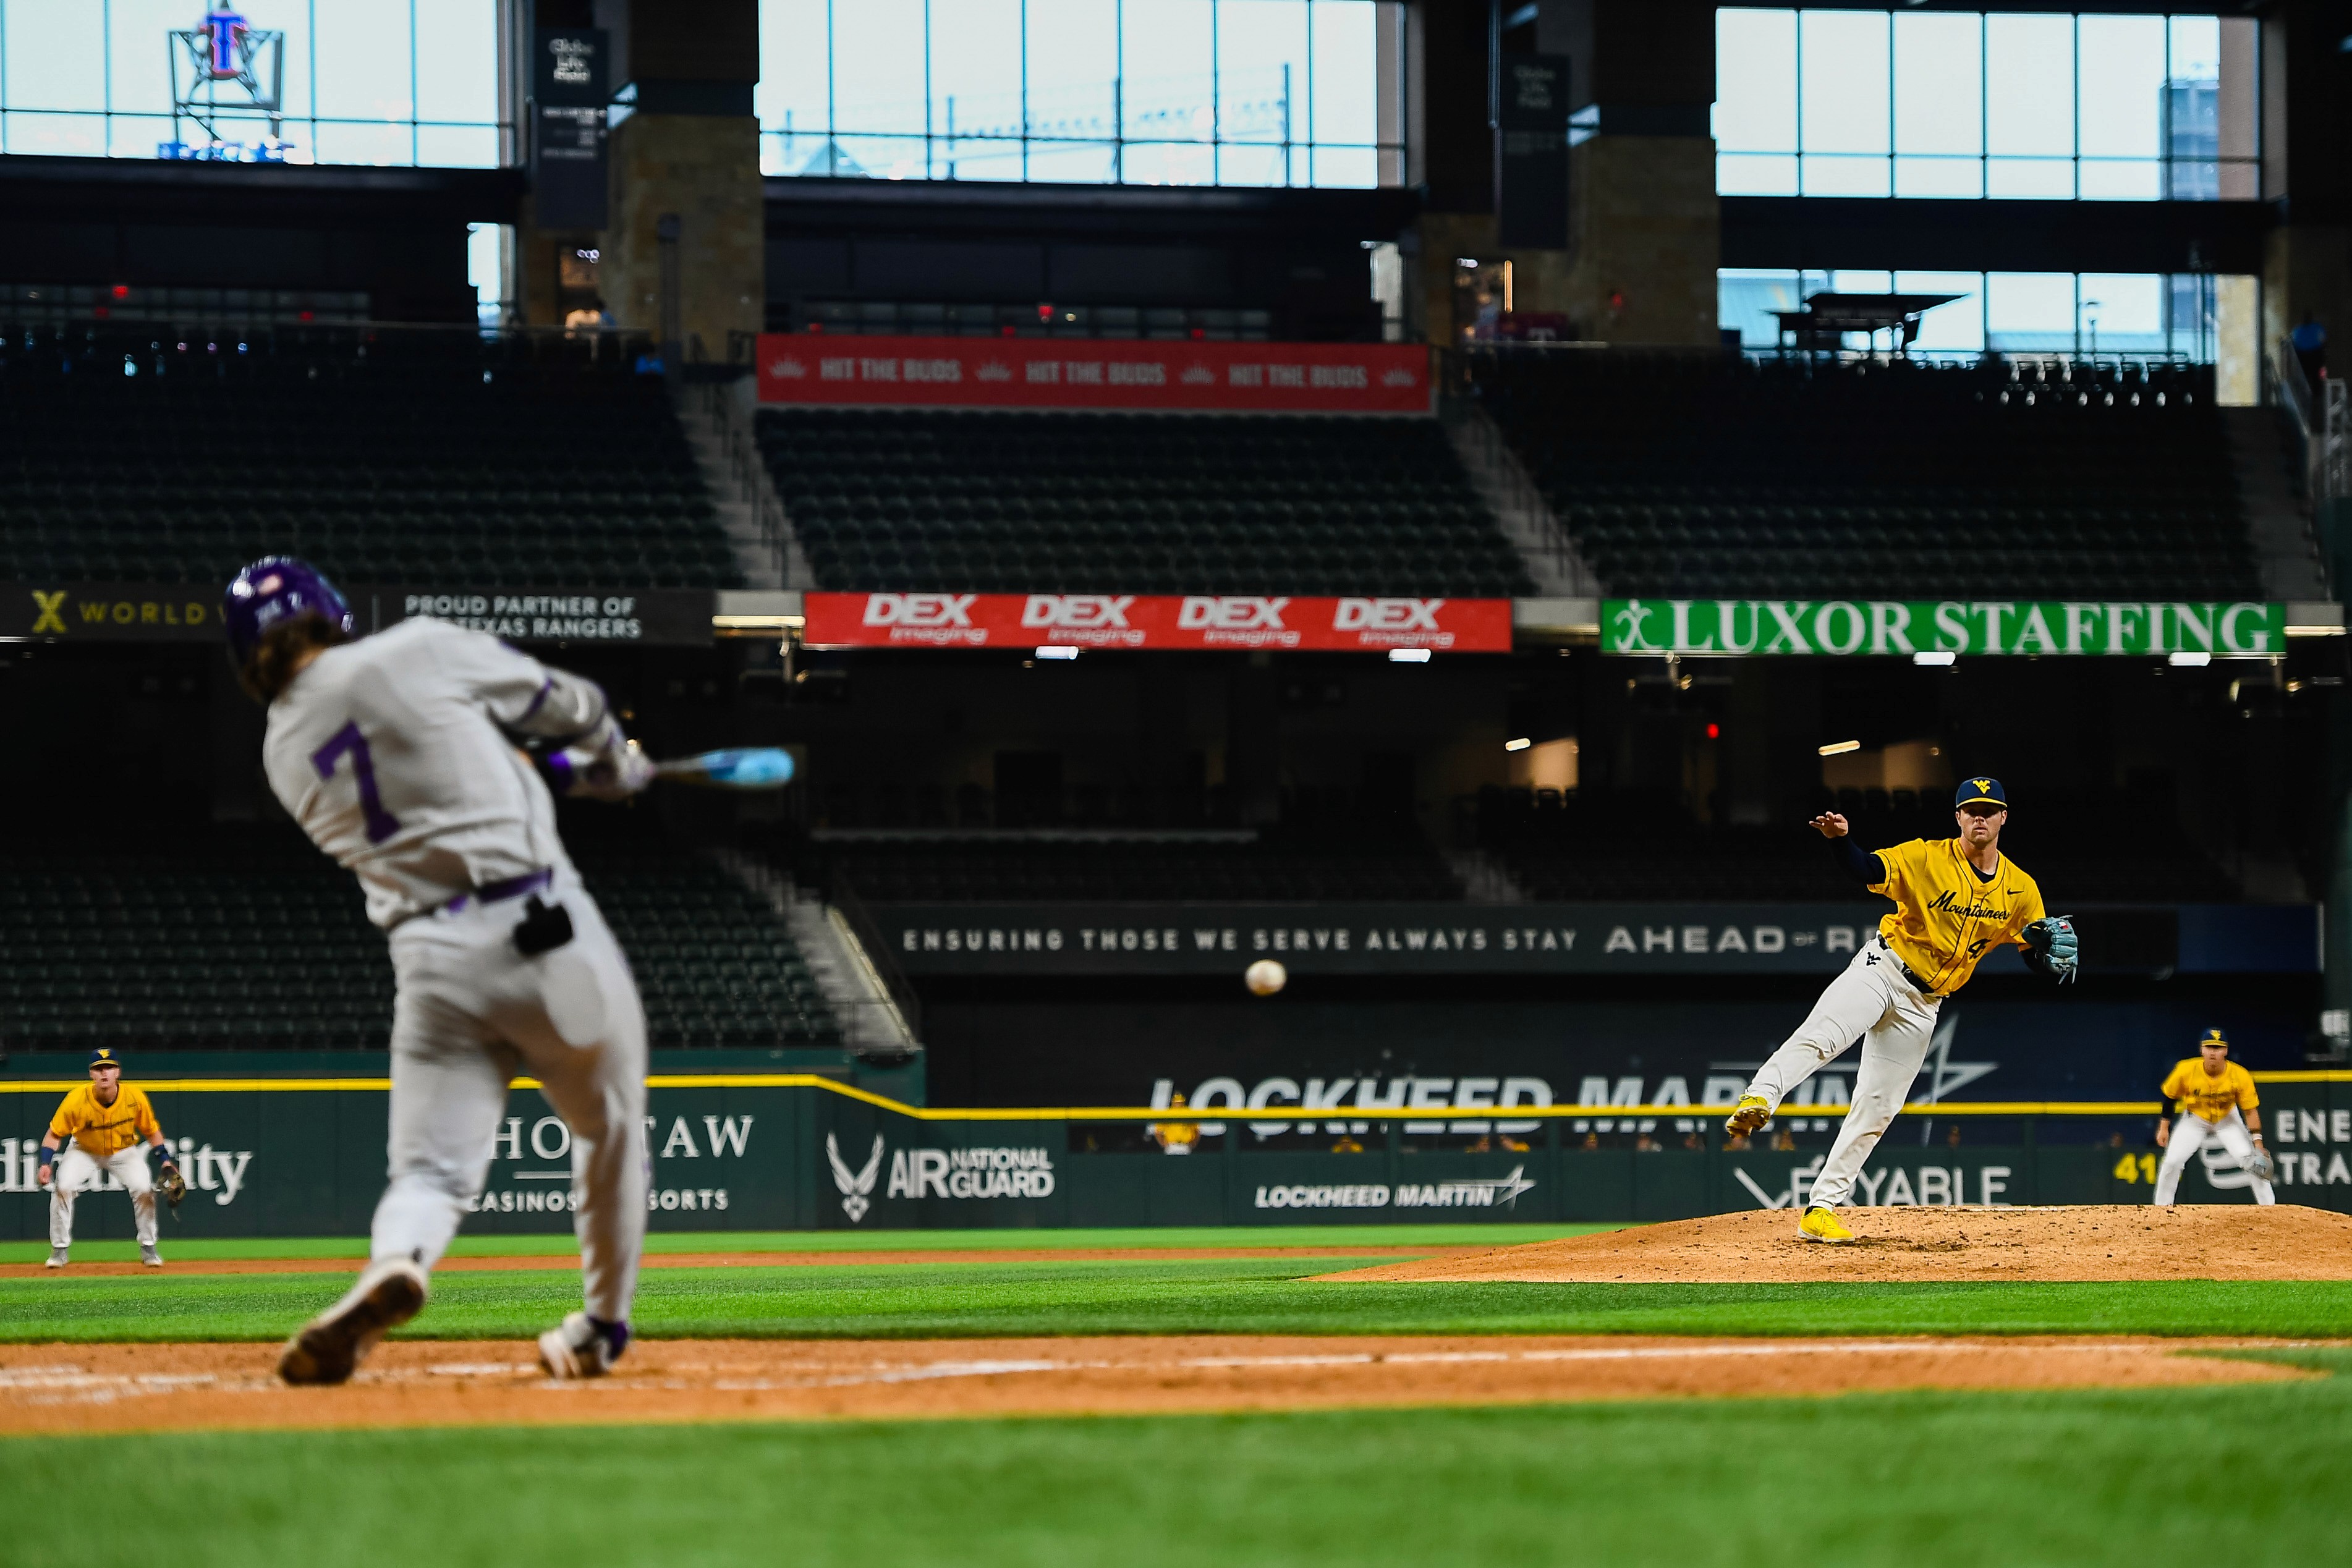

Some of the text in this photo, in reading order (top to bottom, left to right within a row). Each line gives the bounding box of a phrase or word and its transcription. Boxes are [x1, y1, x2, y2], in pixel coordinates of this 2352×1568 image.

[861, 357, 899, 381] THE
[1065, 360, 1103, 385] THE
[1268, 363, 1306, 388] THE
[80, 602, 206, 625] WORLD
[405, 595, 636, 617] PROUD PARTNER OF
[862, 593, 978, 627] DEX
[1021, 595, 1136, 629] DEX
[1177, 596, 1290, 630] DEX
[1333, 597, 1445, 631] DEX
[533, 618, 642, 638] RANGERS
[1669, 600, 2269, 655] LUXOR STAFFING
[310, 720, 403, 843] 7
[1927, 890, 2010, 920] Mountaineers
[903, 929, 1064, 951] ENSURING
[1081, 929, 1179, 951] THOSE
[1194, 929, 1238, 951] WE
[1252, 929, 1351, 951] SERVE
[1365, 929, 1487, 951] ALWAYS
[1503, 929, 1577, 951] STAY
[1605, 925, 1786, 954] AHEAD
[1146, 1075, 1851, 1137] LOCKHEED MARIN
[887, 1147, 1055, 1199] AIR NATIONAL
[949, 1170, 1056, 1198] GUARD
[1254, 1184, 1496, 1208] LOCKHEED MARTIN
